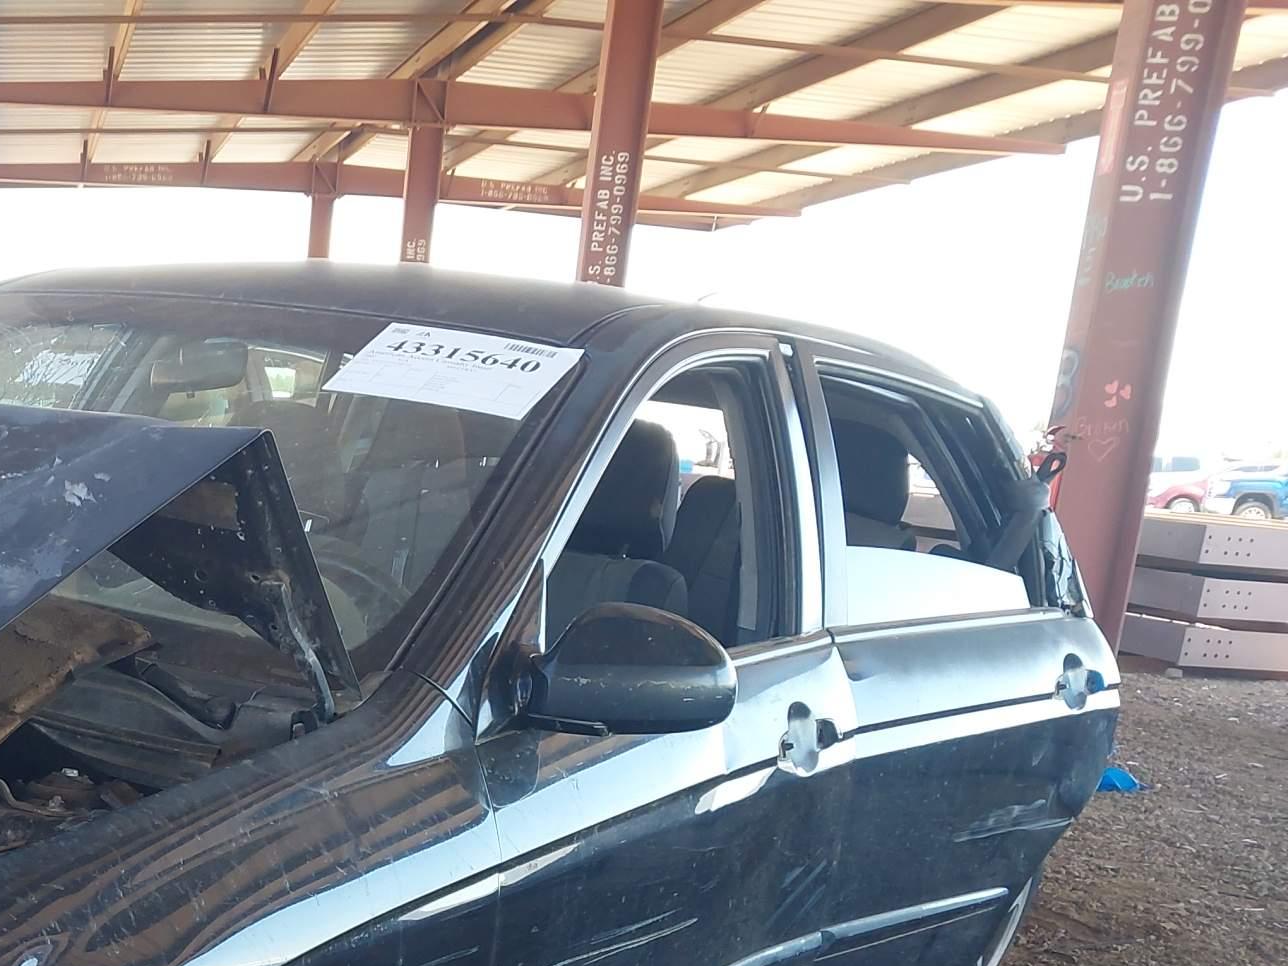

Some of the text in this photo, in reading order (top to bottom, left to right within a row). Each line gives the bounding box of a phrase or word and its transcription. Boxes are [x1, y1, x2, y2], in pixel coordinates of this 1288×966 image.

[1119, 3, 1181, 202] U.S. PREFAB
[586, 150, 616, 284] .S. PREFAB INC.
[386, 340, 541, 373] 43315640
